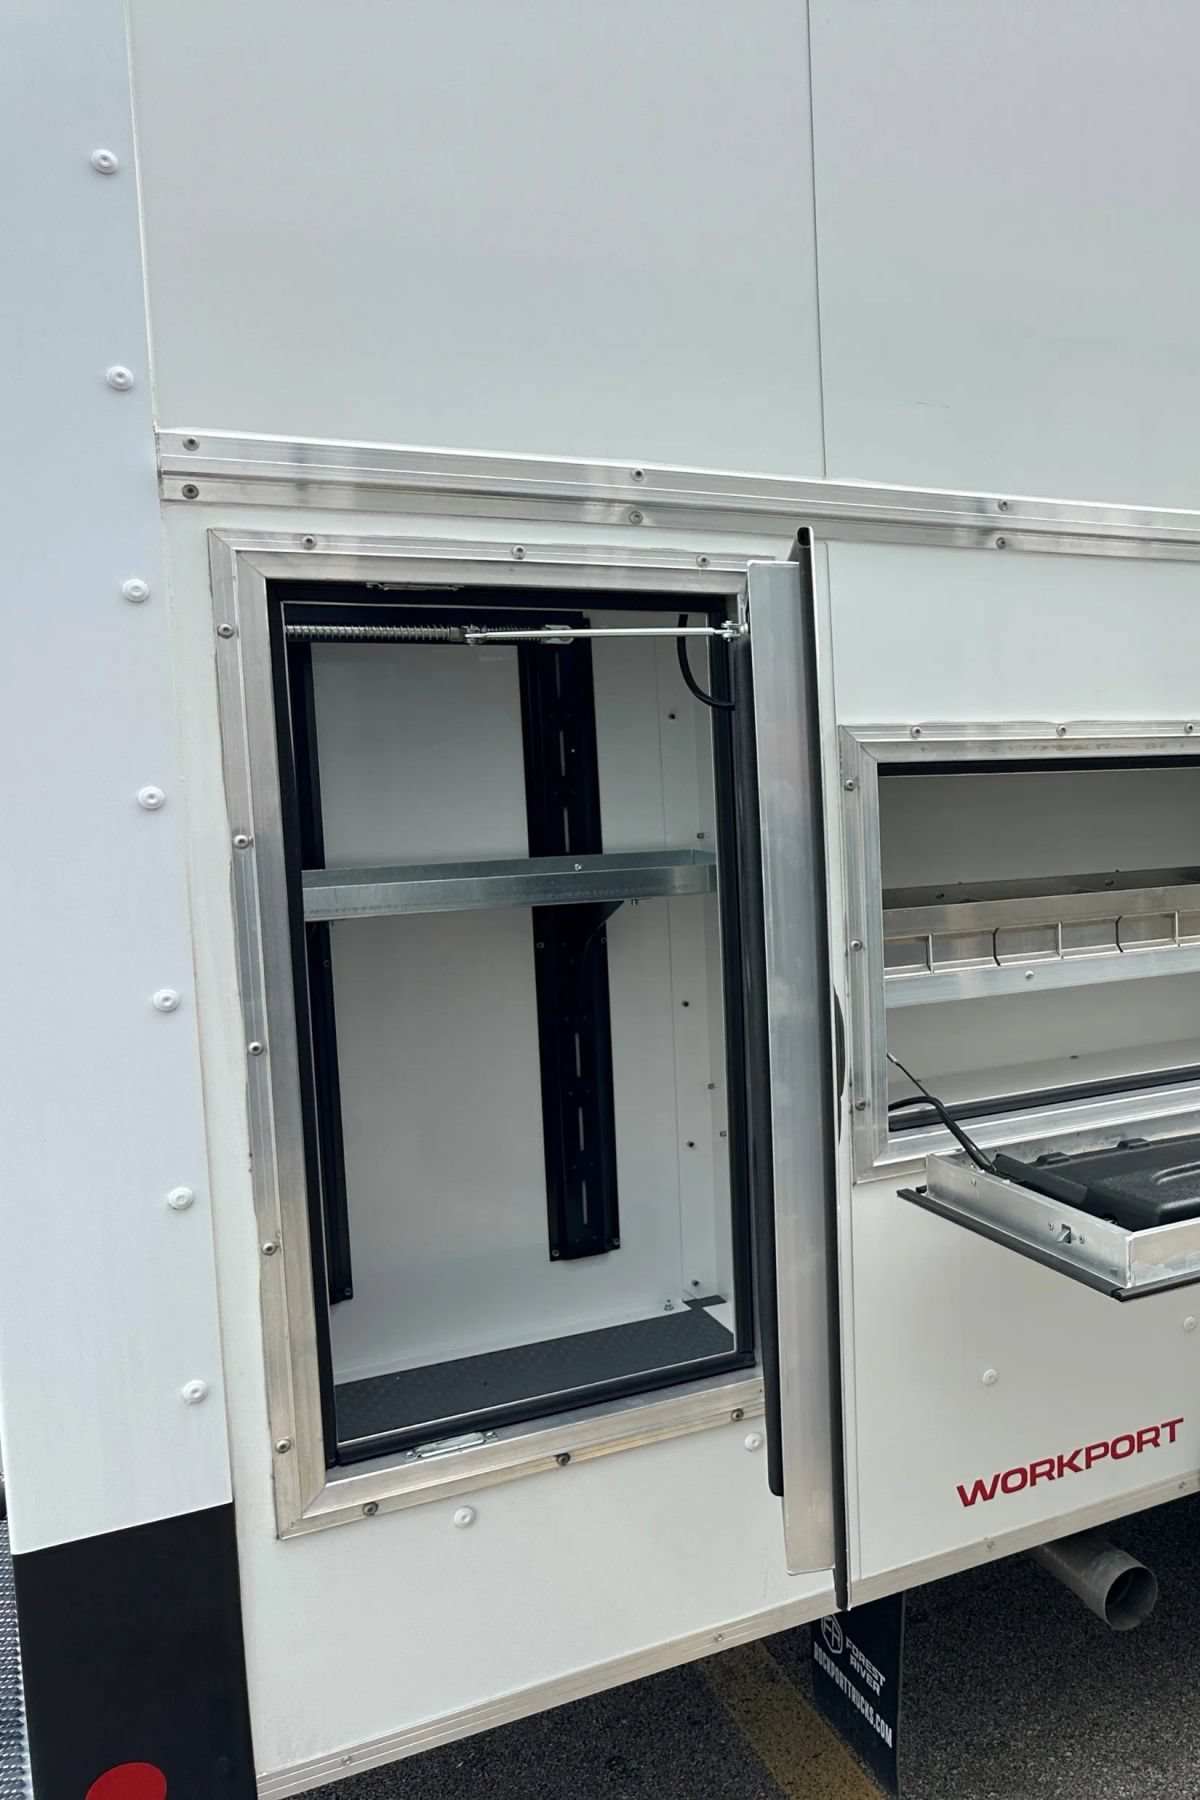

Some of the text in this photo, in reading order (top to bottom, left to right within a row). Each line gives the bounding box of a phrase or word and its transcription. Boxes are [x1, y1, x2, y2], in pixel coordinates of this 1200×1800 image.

[956, 1417, 1184, 1507] WORKPORT
[813, 1641, 893, 1749] ROCKPORTTRUCKS.COM
[845, 1636, 886, 1687] FOREST
[849, 1653, 880, 1697] RIVER
